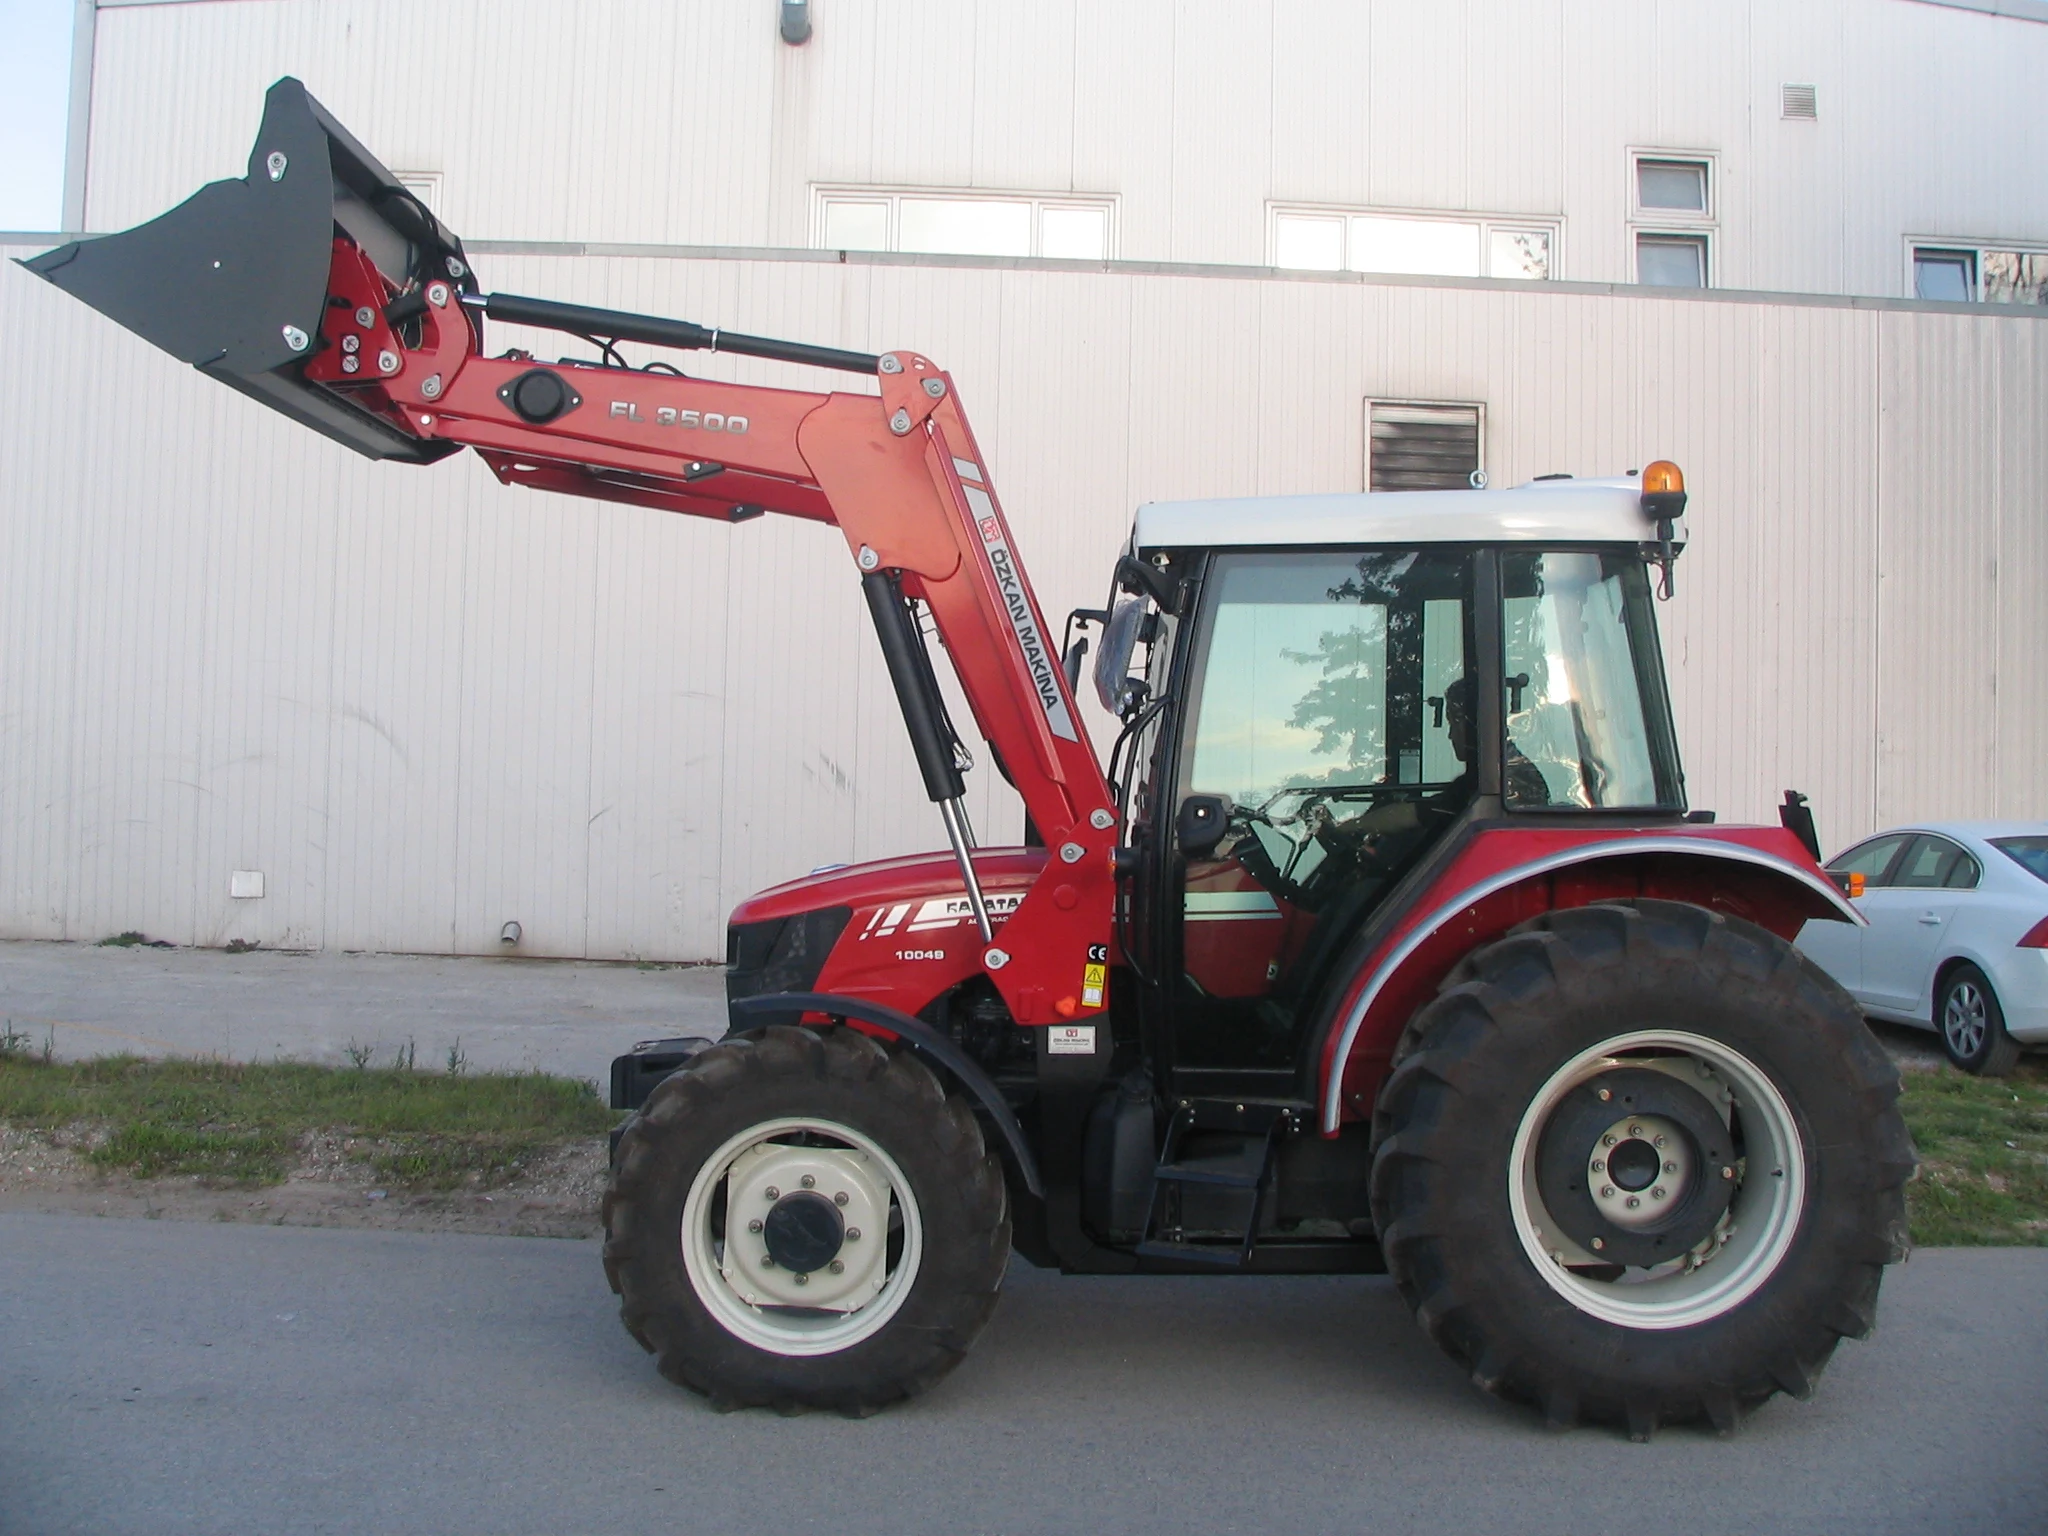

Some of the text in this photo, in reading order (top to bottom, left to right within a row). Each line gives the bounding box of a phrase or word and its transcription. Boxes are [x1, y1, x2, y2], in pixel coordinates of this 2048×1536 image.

[609, 400, 749, 435] FL 3500
[990, 547, 1059, 711] ÖZKAN MAKİNA
[1088, 945, 1107, 960] CE
